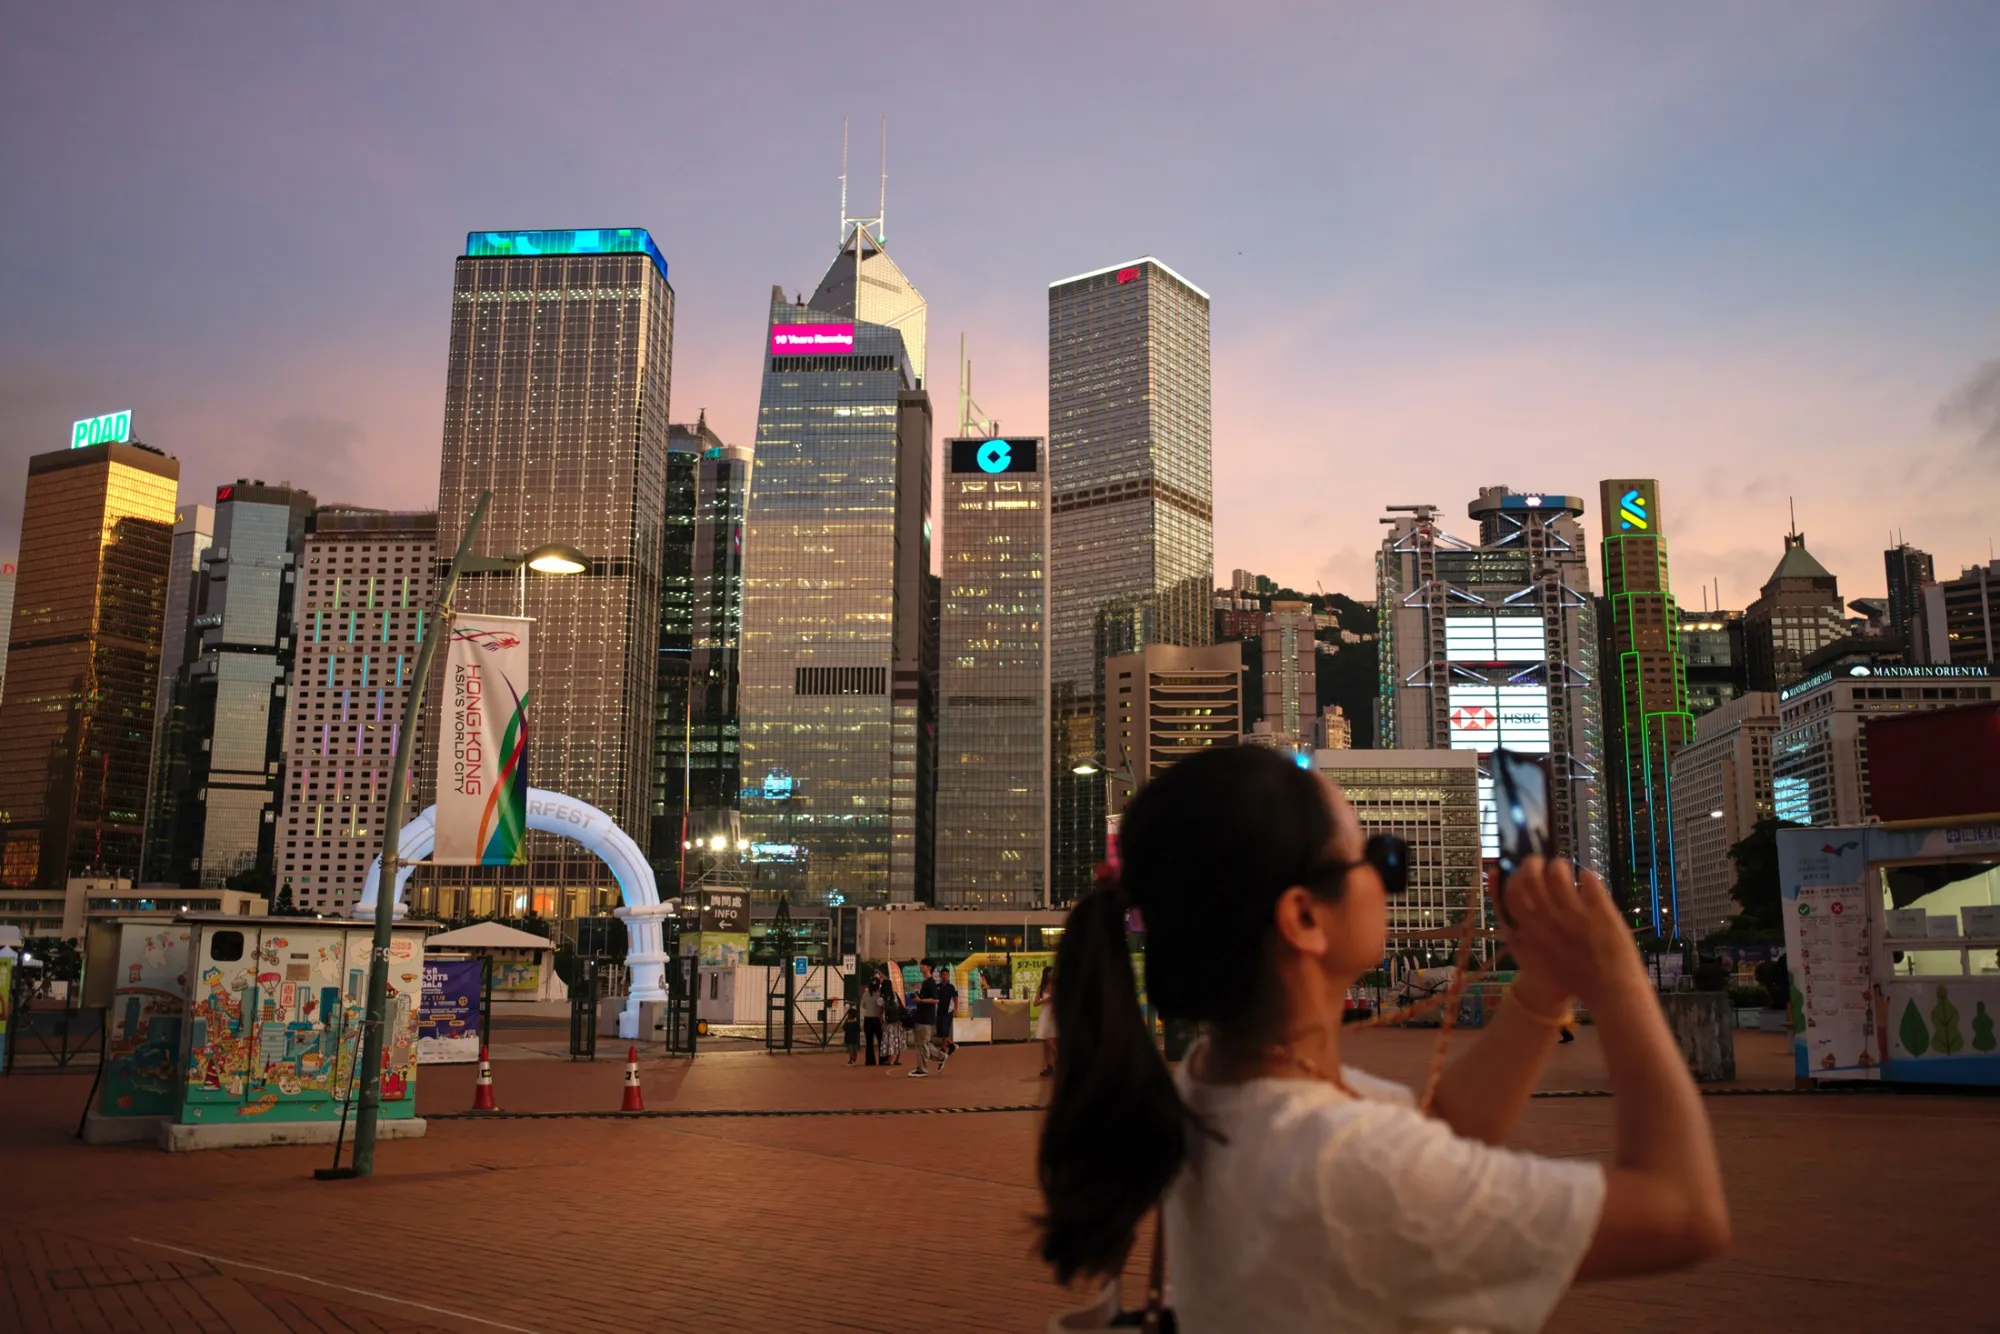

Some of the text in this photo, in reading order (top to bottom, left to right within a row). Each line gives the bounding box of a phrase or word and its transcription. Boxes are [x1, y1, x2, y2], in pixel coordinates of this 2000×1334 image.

[74, 413, 128, 449] POAD
[1873, 666, 1990, 677] MANDARIN ORIENTAL
[1503, 712, 1541, 725] HSBC
[454, 664, 465, 795] ASIA'S WORLD CITY
[465, 664, 482, 796] HONG KONG
[714, 909, 738, 919] INFO
[374, 946, 390, 963] F9
[846, 963, 854, 971] 17
